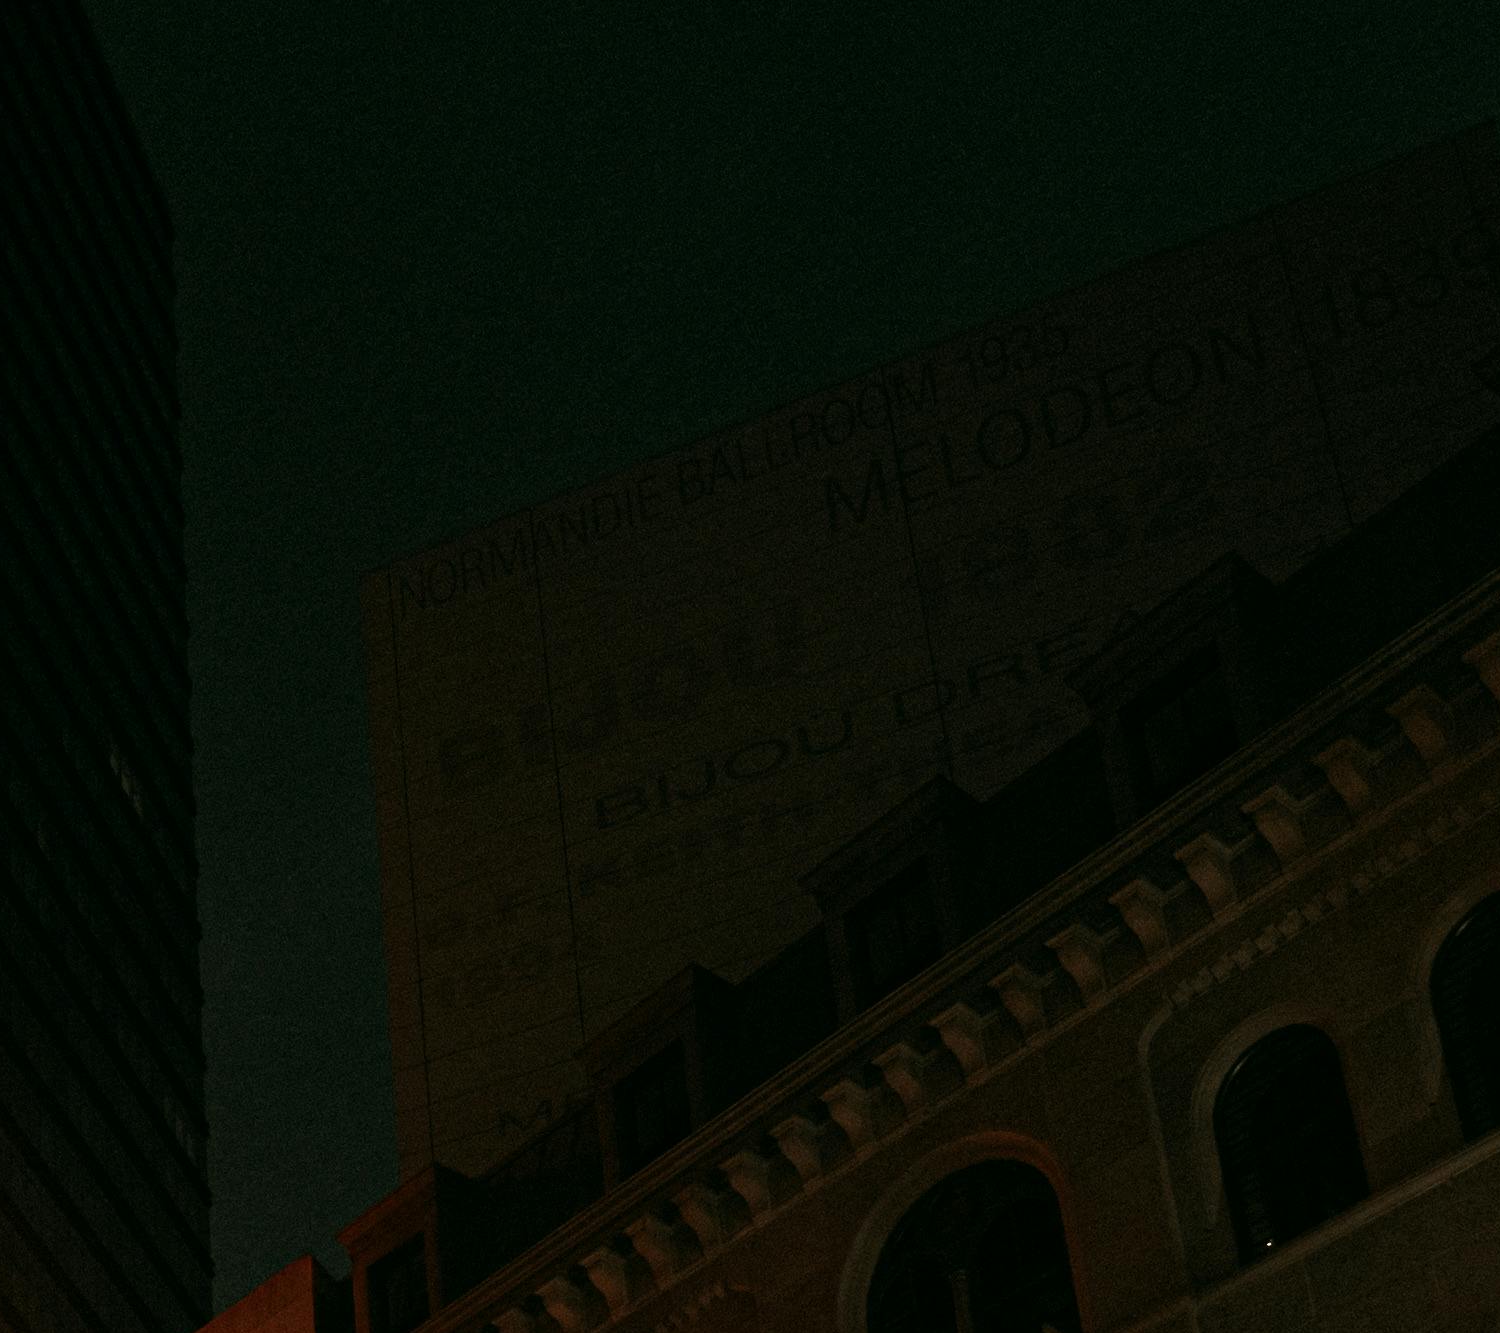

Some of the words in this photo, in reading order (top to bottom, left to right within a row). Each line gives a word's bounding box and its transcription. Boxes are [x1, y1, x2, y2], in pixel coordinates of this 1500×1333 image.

[678, 366, 942, 502] BALLROOM
[823, 315, 1270, 534] MELODEON
[592, 710, 853, 829] BIJOU
